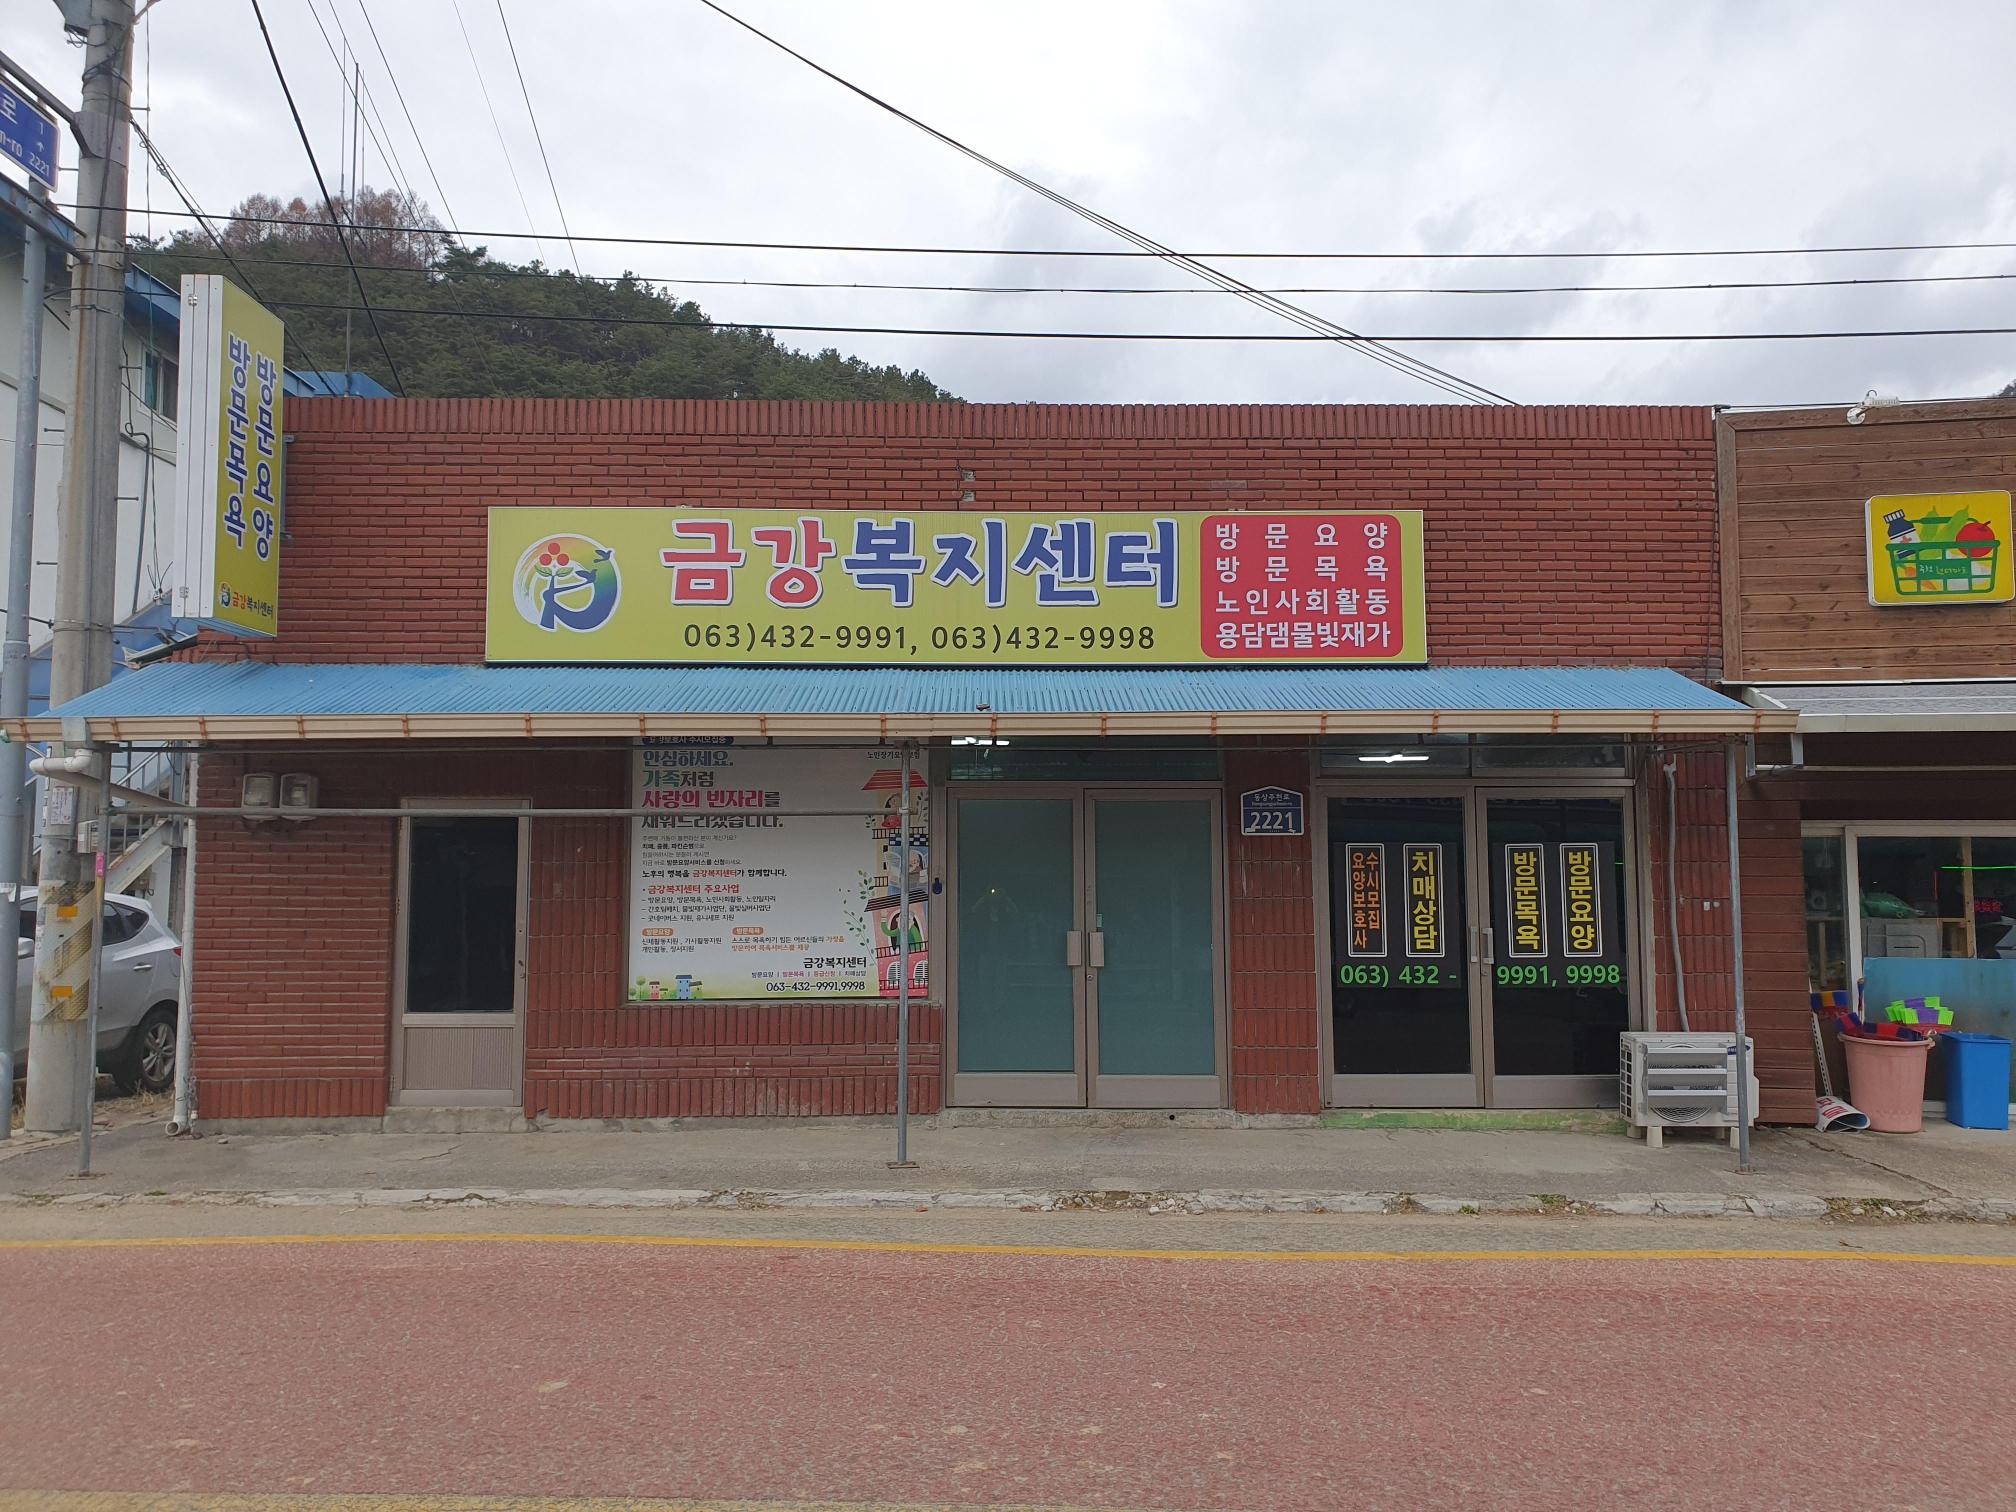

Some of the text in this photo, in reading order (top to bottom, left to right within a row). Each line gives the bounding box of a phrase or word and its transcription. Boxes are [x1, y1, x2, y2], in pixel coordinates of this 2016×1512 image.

[28, 151, 50, 177] 2221
[225, 331, 252, 549] 방문목욕
[253, 351, 278, 560] 방문요양
[659, 516, 1179, 608] 금강복지센터
[231, 590, 275, 618] 금강복지센터
[1215, 588, 1390, 616] 노인사회활동
[684, 625, 1155, 655] 063)432-9991, 063)432-9998
[1215, 621, 1391, 650] 용담댐물빛재가
[643, 750, 734, 767] 안심하세요.
[642, 770, 714, 788] 가족처럼
[641, 790, 781, 809] 사랑의 빈자리를
[1250, 811, 1294, 830] 2221
[642, 868, 787, 878] 노후의 행복을 금강복지센터가 함께합니다.
[647, 883, 740, 895] 금강복지센터 주요사업
[1352, 852, 1367, 949] 요양보호사
[1366, 851, 1380, 929] 수시모집
[1412, 851, 1438, 950] 치매상담
[1513, 851, 1540, 950] 방문목욕
[1568, 850, 1595, 950] 방문요양
[685, 937, 722, 945] 가사활동지원
[751, 971, 774, 979] 방문요양
[803, 956, 867, 969] 금강복지센터
[1340, 964, 1389, 988] 063)
[1399, 965, 1440, 984] 432
[1497, 965, 1557, 988] 9991,
[1566, 964, 1620, 984] 9998
[766, 981, 866, 992] 063-432-9991,9998
